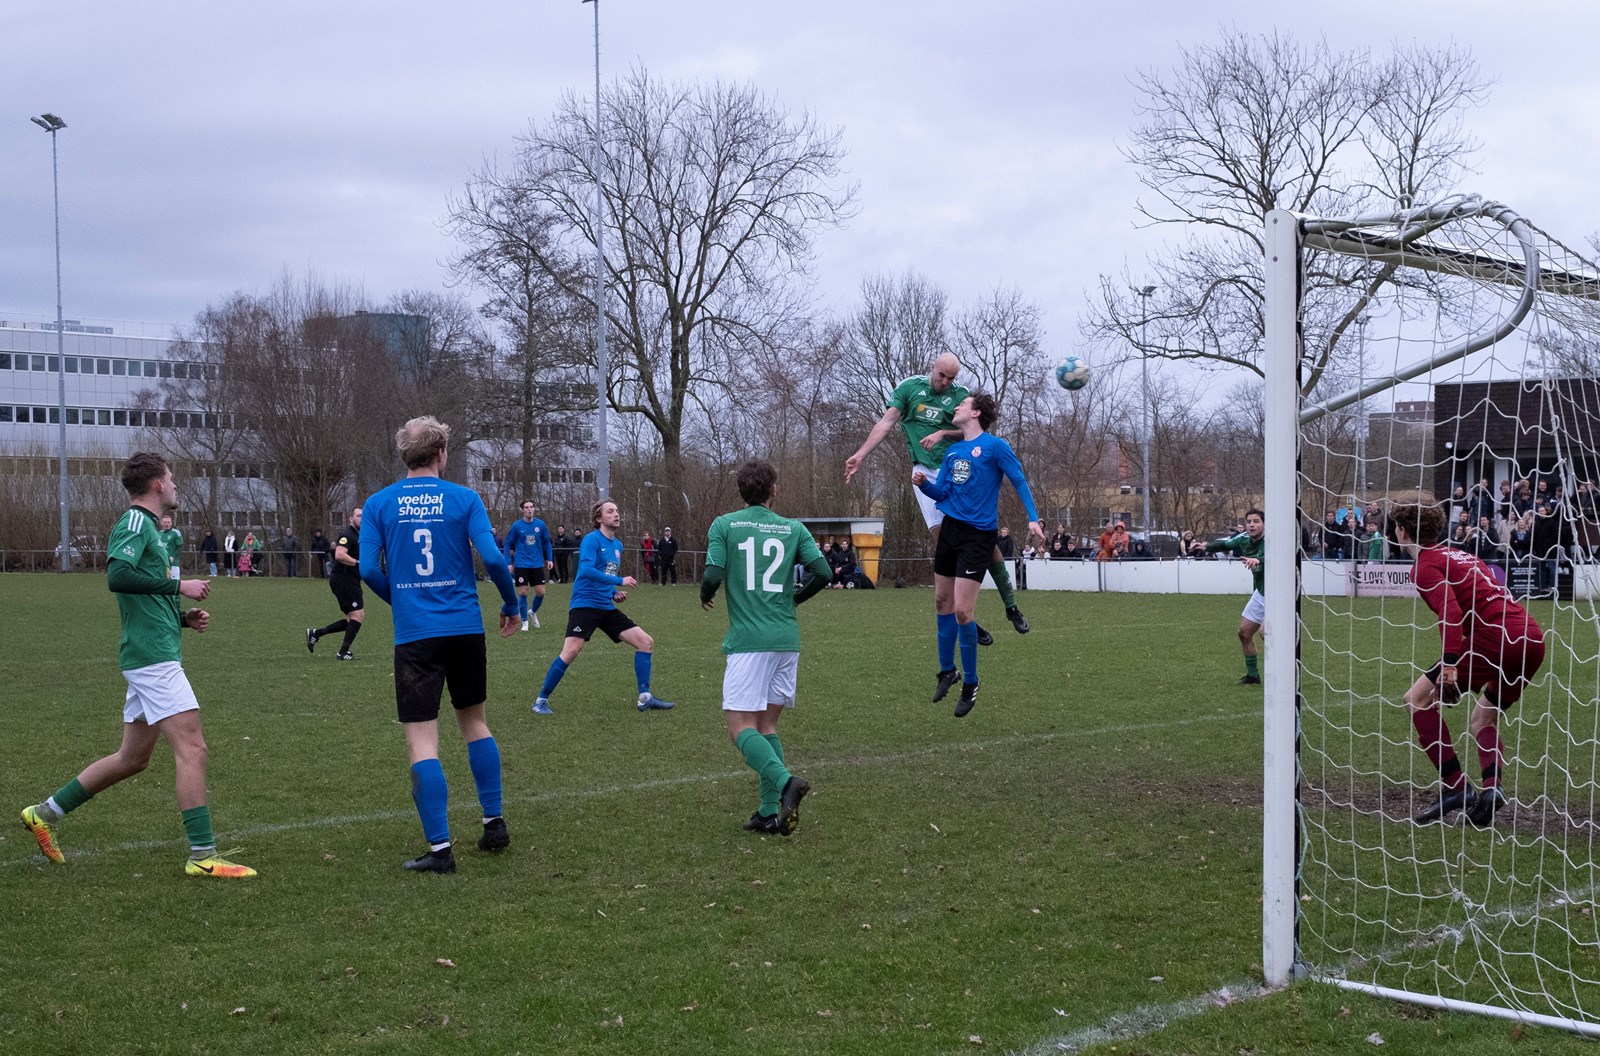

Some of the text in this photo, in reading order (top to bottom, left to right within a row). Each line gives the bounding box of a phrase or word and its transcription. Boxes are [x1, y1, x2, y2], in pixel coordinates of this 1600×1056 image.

[926, 410, 939, 419] 97
[397, 493, 444, 505] voetbal
[398, 503, 444, 518] shop.nl
[413, 528, 435, 577] 3
[737, 536, 785, 593] 12
[1387, 571, 1410, 584] YOUR
